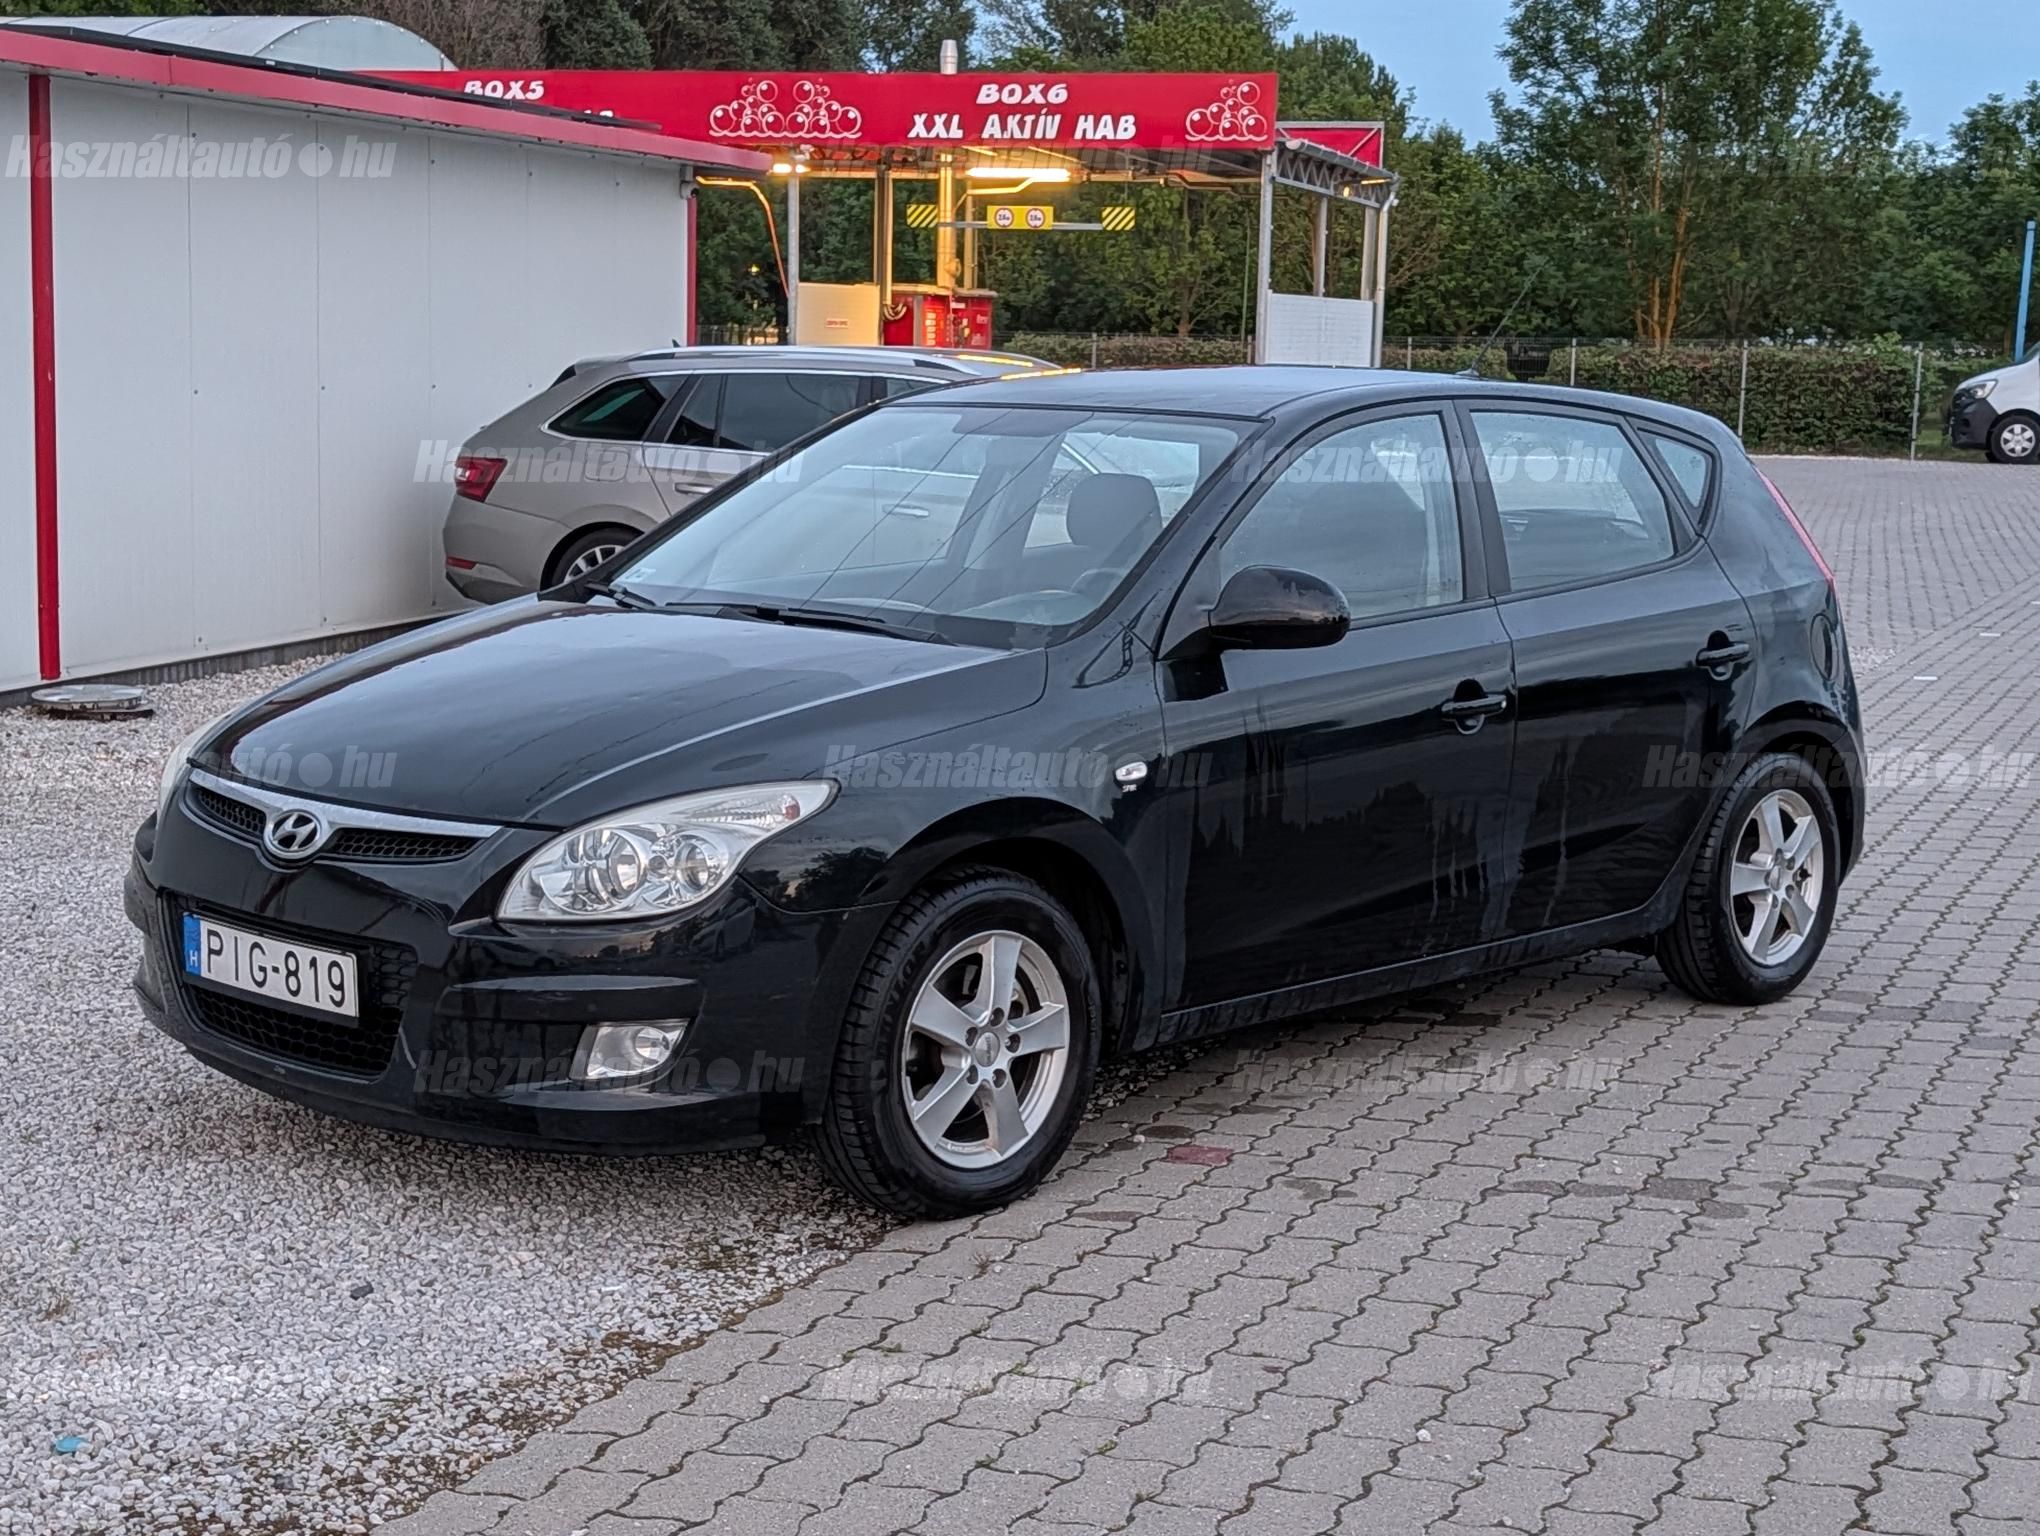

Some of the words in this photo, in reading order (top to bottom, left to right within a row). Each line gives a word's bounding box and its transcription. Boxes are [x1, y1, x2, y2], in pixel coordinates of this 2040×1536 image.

[464, 80, 545, 100] BOX5
[976, 83, 1069, 104] BOX6
[907, 113, 964, 138] XXL
[981, 107, 1062, 139] AKTÍV
[1074, 114, 1137, 140] HAB
[207, 928, 345, 1008] PIG-819
